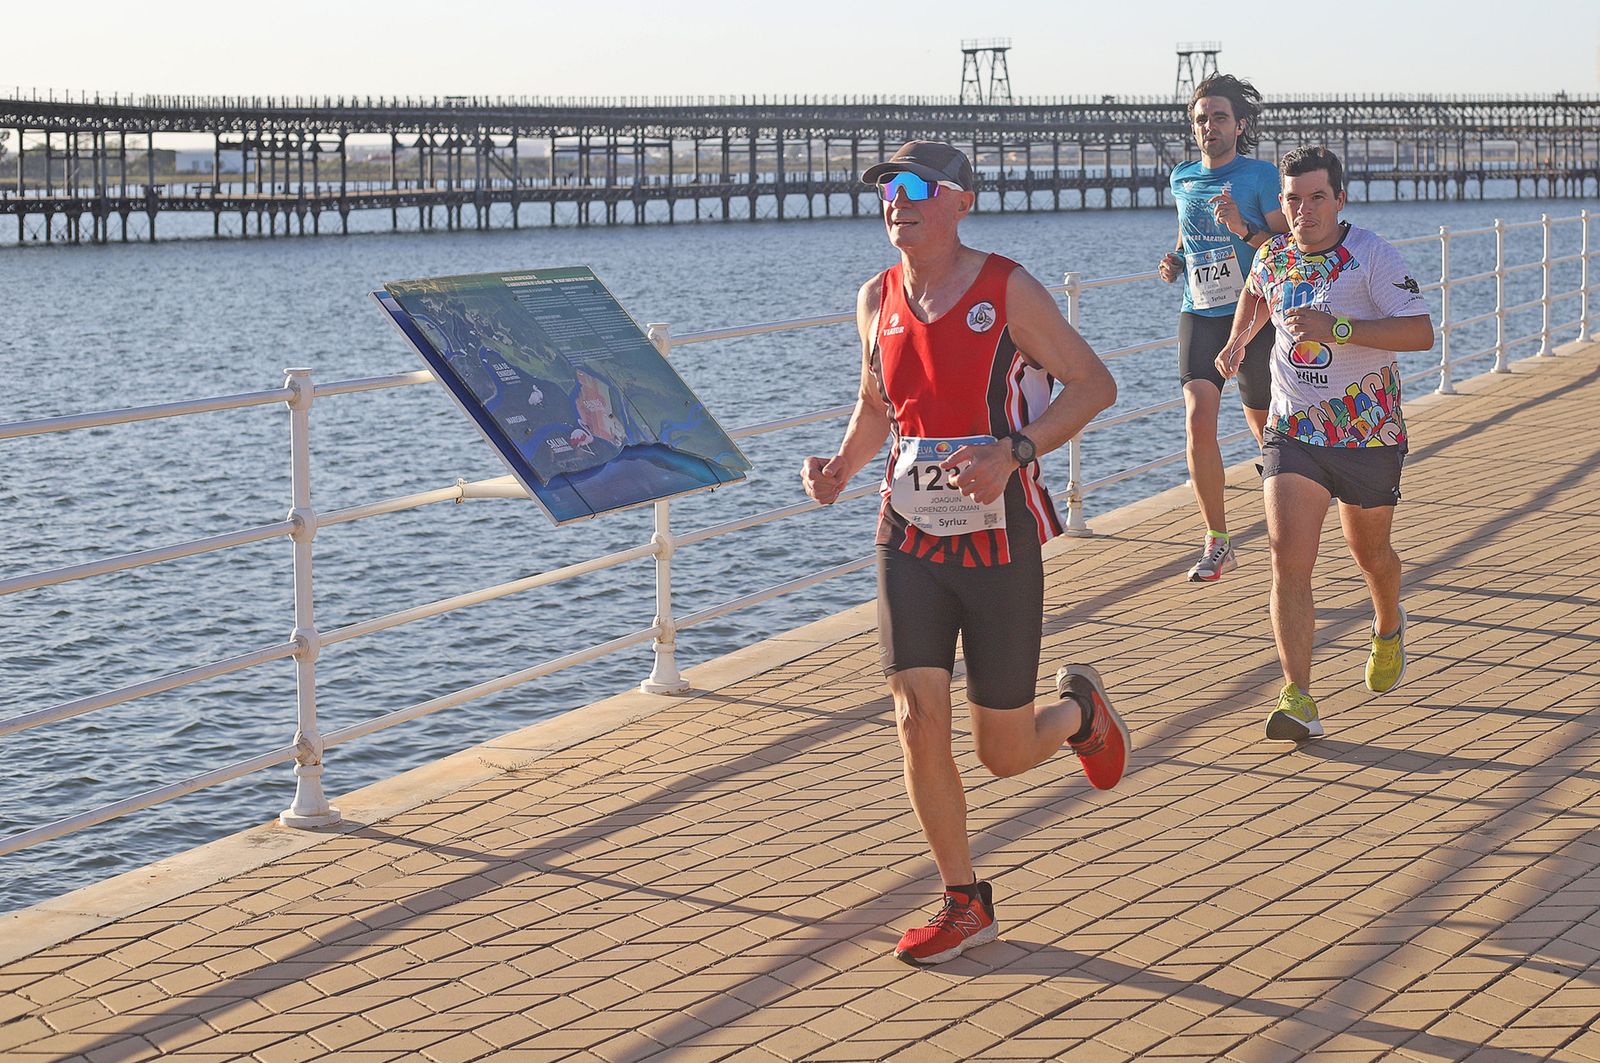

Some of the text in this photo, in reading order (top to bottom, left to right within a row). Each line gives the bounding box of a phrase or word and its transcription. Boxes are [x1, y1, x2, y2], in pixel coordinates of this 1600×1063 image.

[1194, 263, 1231, 284] 1724
[908, 466, 968, 491] 123
[914, 505, 948, 513] LORENZO
